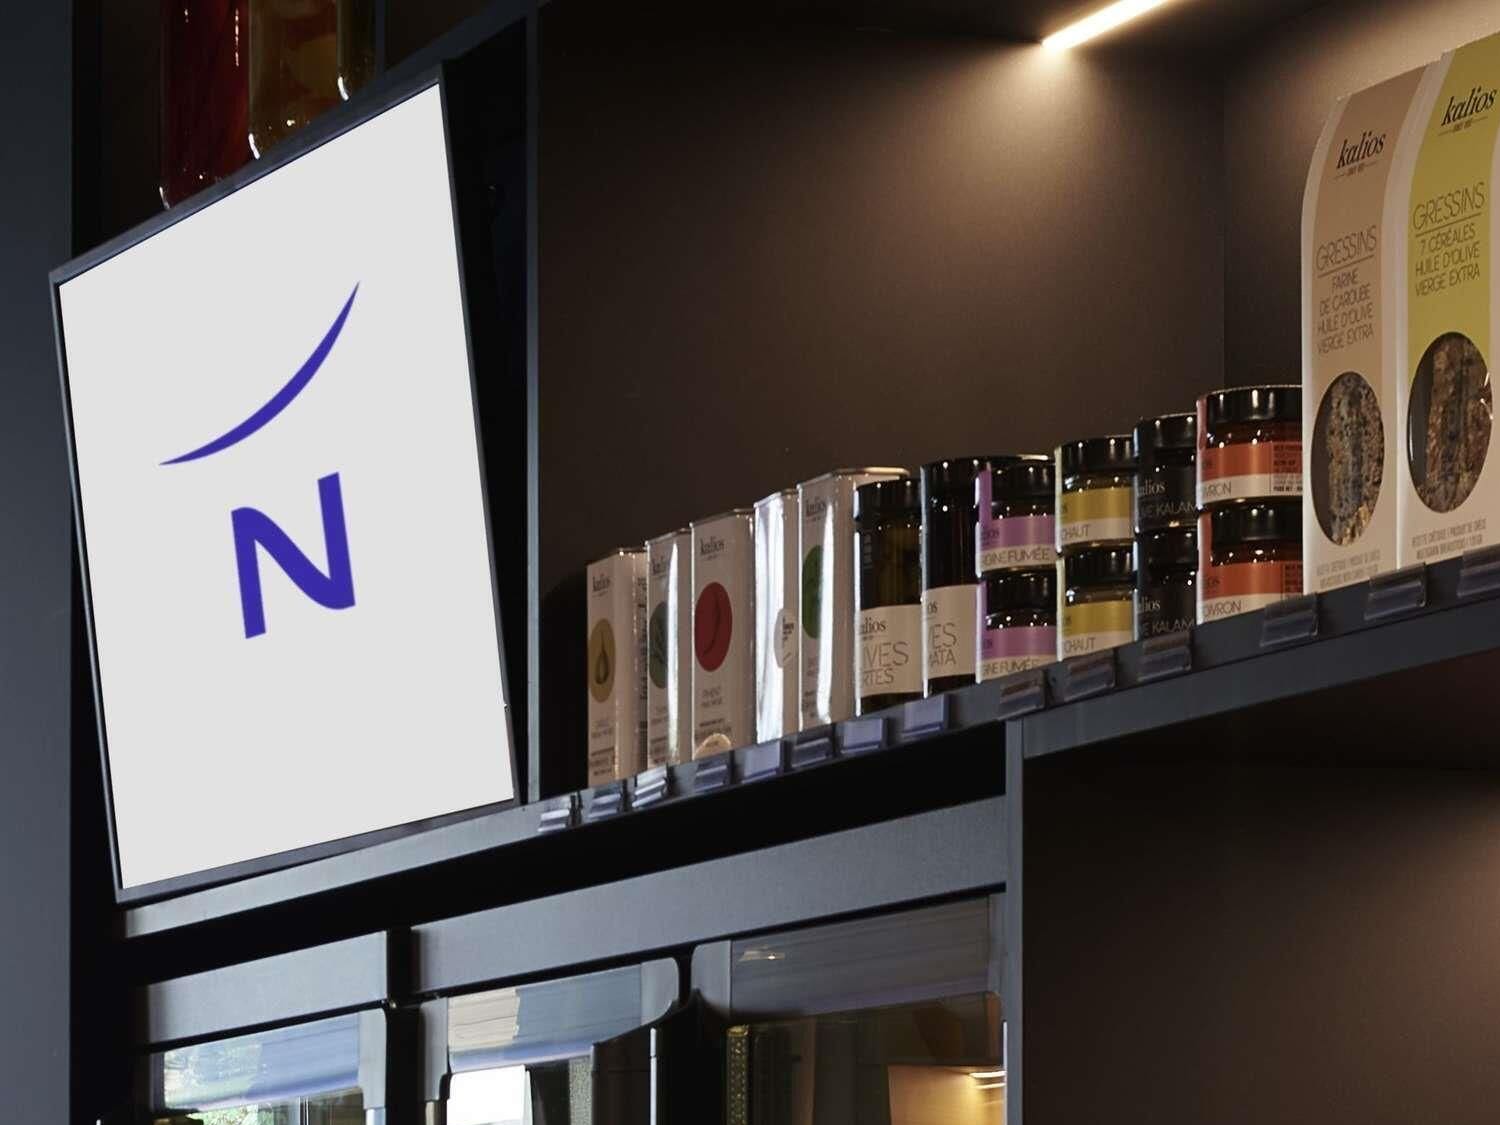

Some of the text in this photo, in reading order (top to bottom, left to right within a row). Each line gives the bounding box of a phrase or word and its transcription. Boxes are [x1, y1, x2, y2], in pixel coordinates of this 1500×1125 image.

[1441, 86, 1498, 127] kalios
[1336, 131, 1387, 169] kalios
[1413, 181, 1485, 230] GRESSINS
[1315, 225, 1378, 271] GRESSINS
[1449, 263, 1481, 287] EXTRA
[1347, 323, 1374, 346] EXTRA
[230, 471, 356, 640] N
[1007, 547, 1050, 563] FUMÉE
